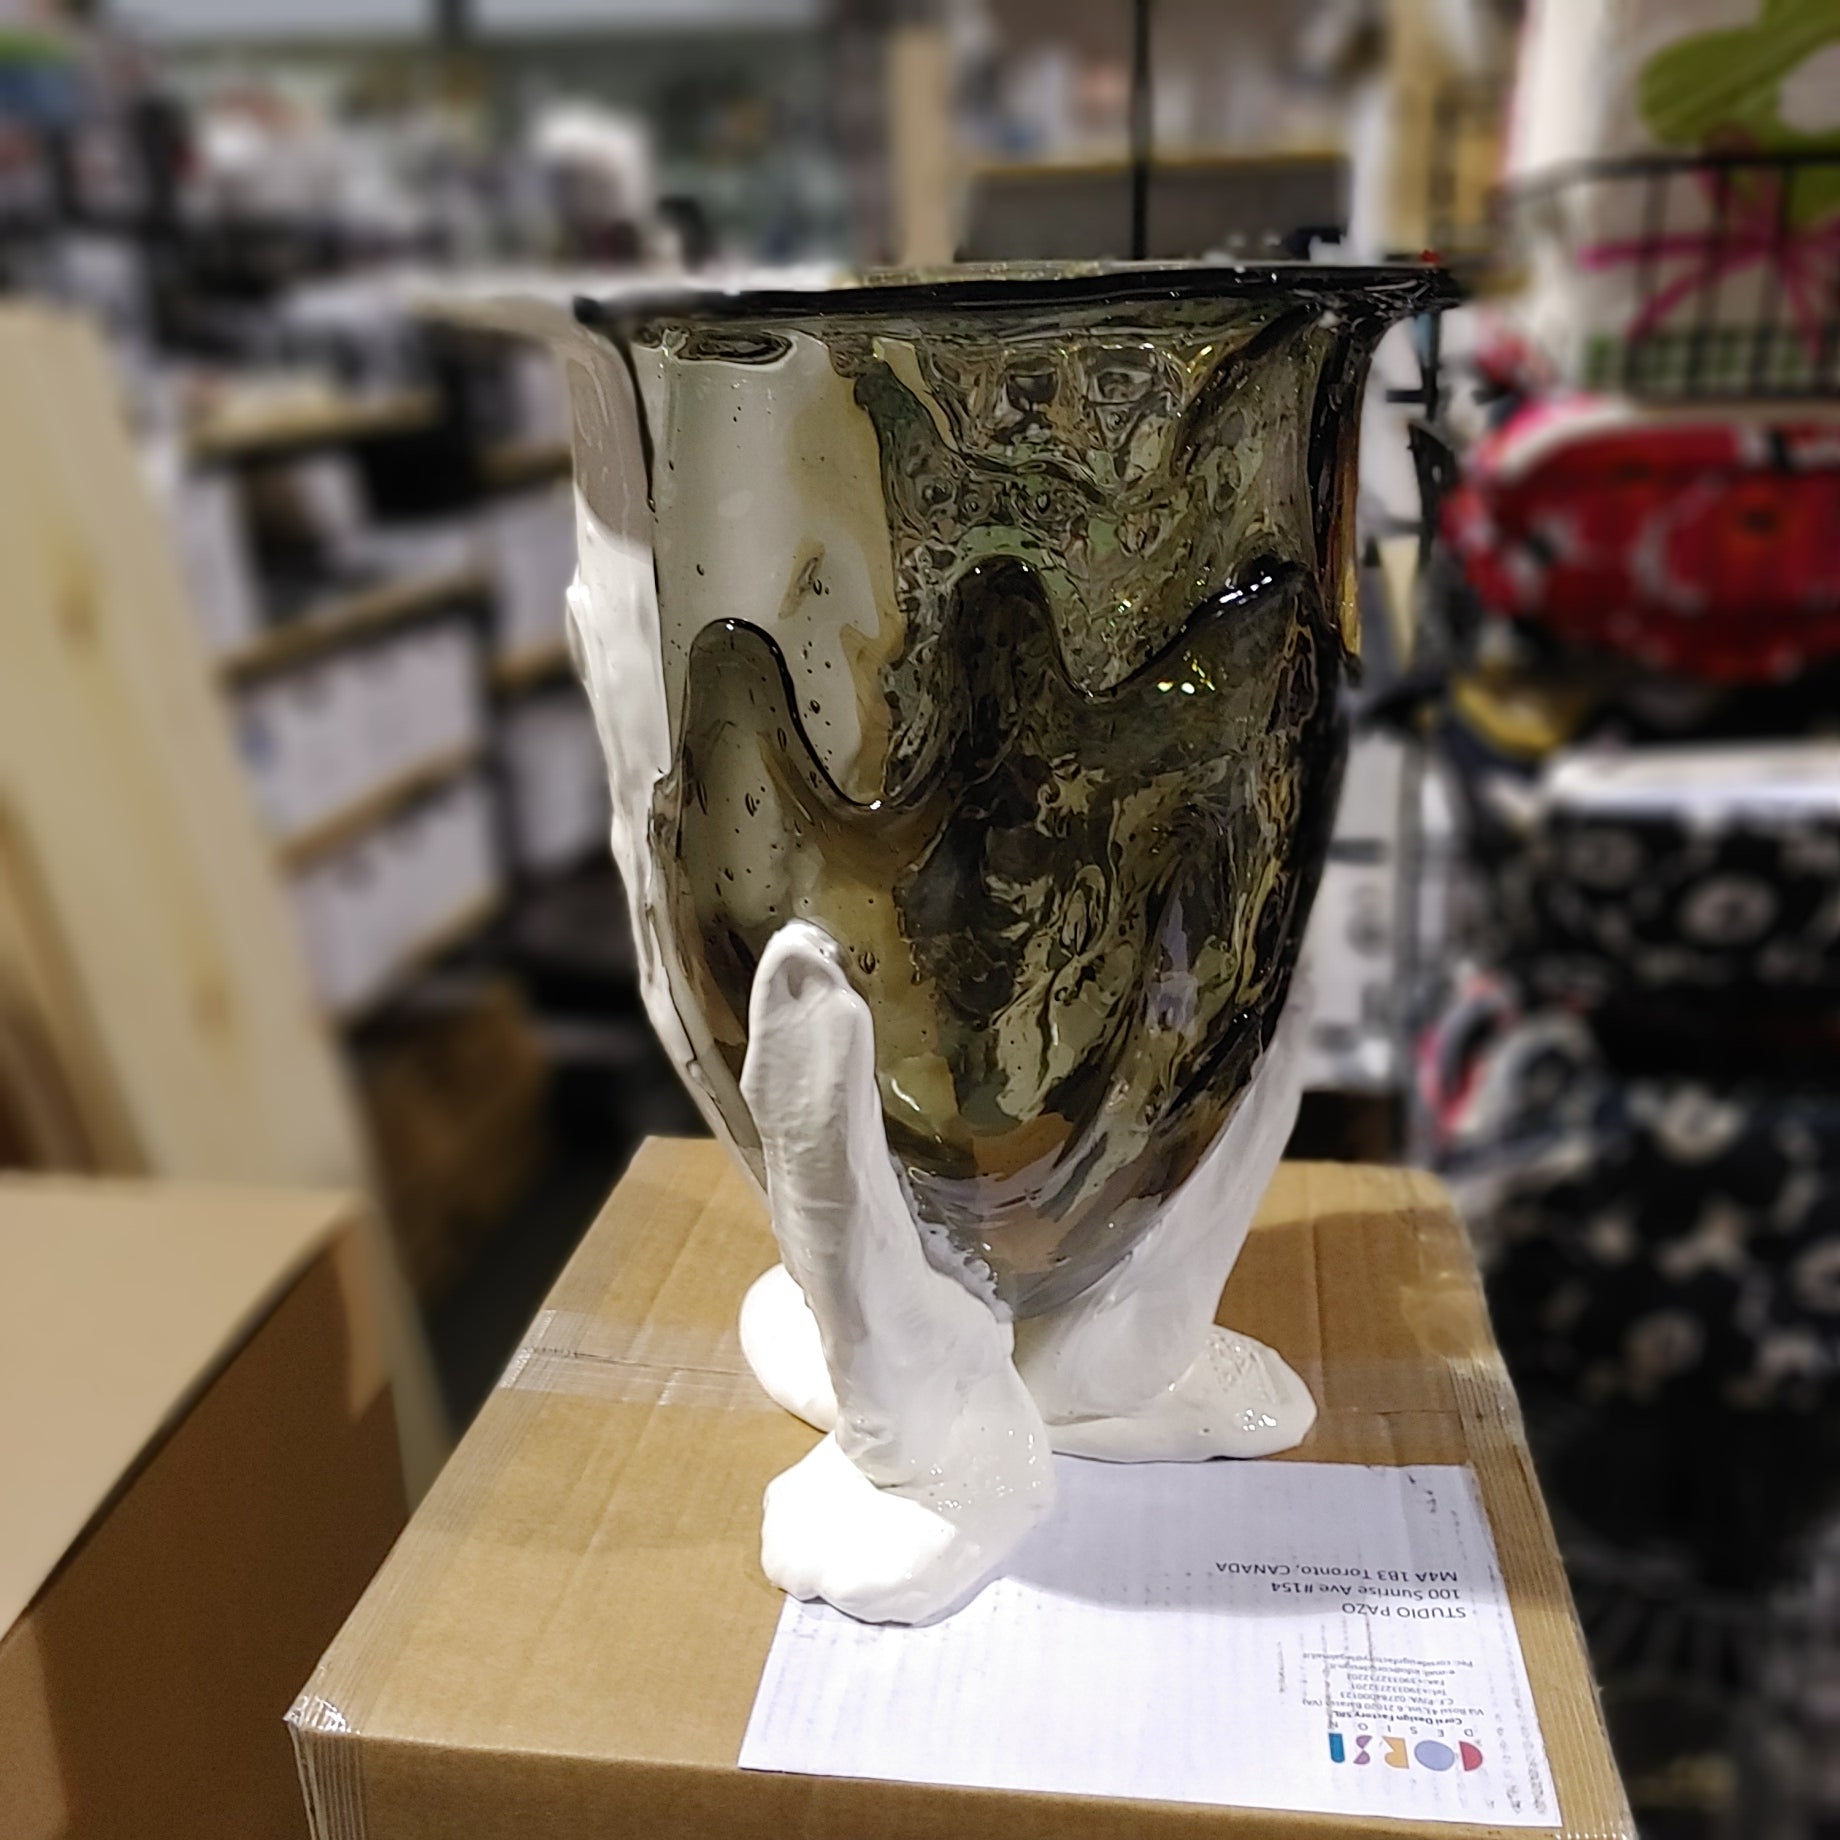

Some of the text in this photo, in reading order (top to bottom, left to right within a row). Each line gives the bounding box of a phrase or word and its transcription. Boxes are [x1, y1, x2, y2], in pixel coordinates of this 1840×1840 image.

[1215, 1562, 1457, 1582] M4A 1B3 Toronto, CANADA
[1271, 1582, 1460, 1601] 100 Sunrise Ave #154
[1341, 1602, 1466, 1619] STUDIO PAZO
[1333, 1710, 1462, 1725] Corsi Design Factory SRL
[1328, 1732, 1483, 1772] CORSI
